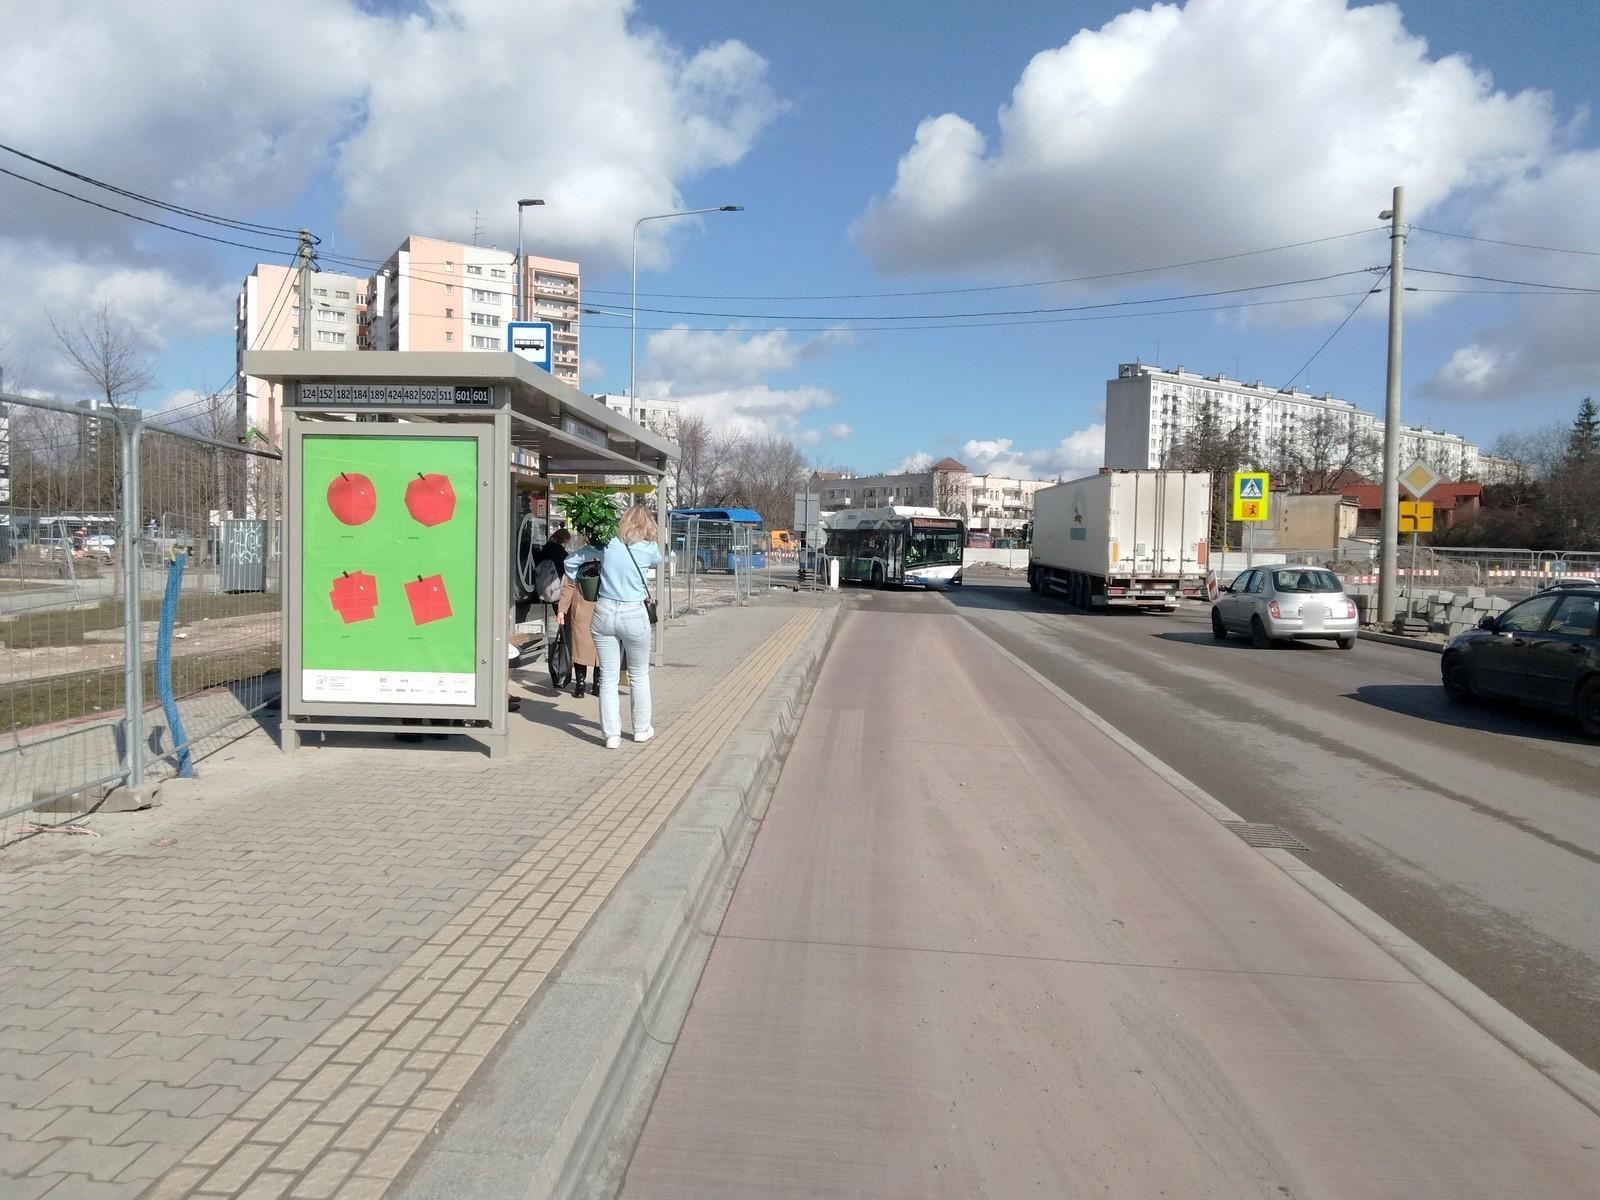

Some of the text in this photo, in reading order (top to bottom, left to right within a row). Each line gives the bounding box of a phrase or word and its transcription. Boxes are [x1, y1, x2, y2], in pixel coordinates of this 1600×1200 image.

[303, 390, 488, 401] 124 152 182 184 189 424 482 502 511 601 601
